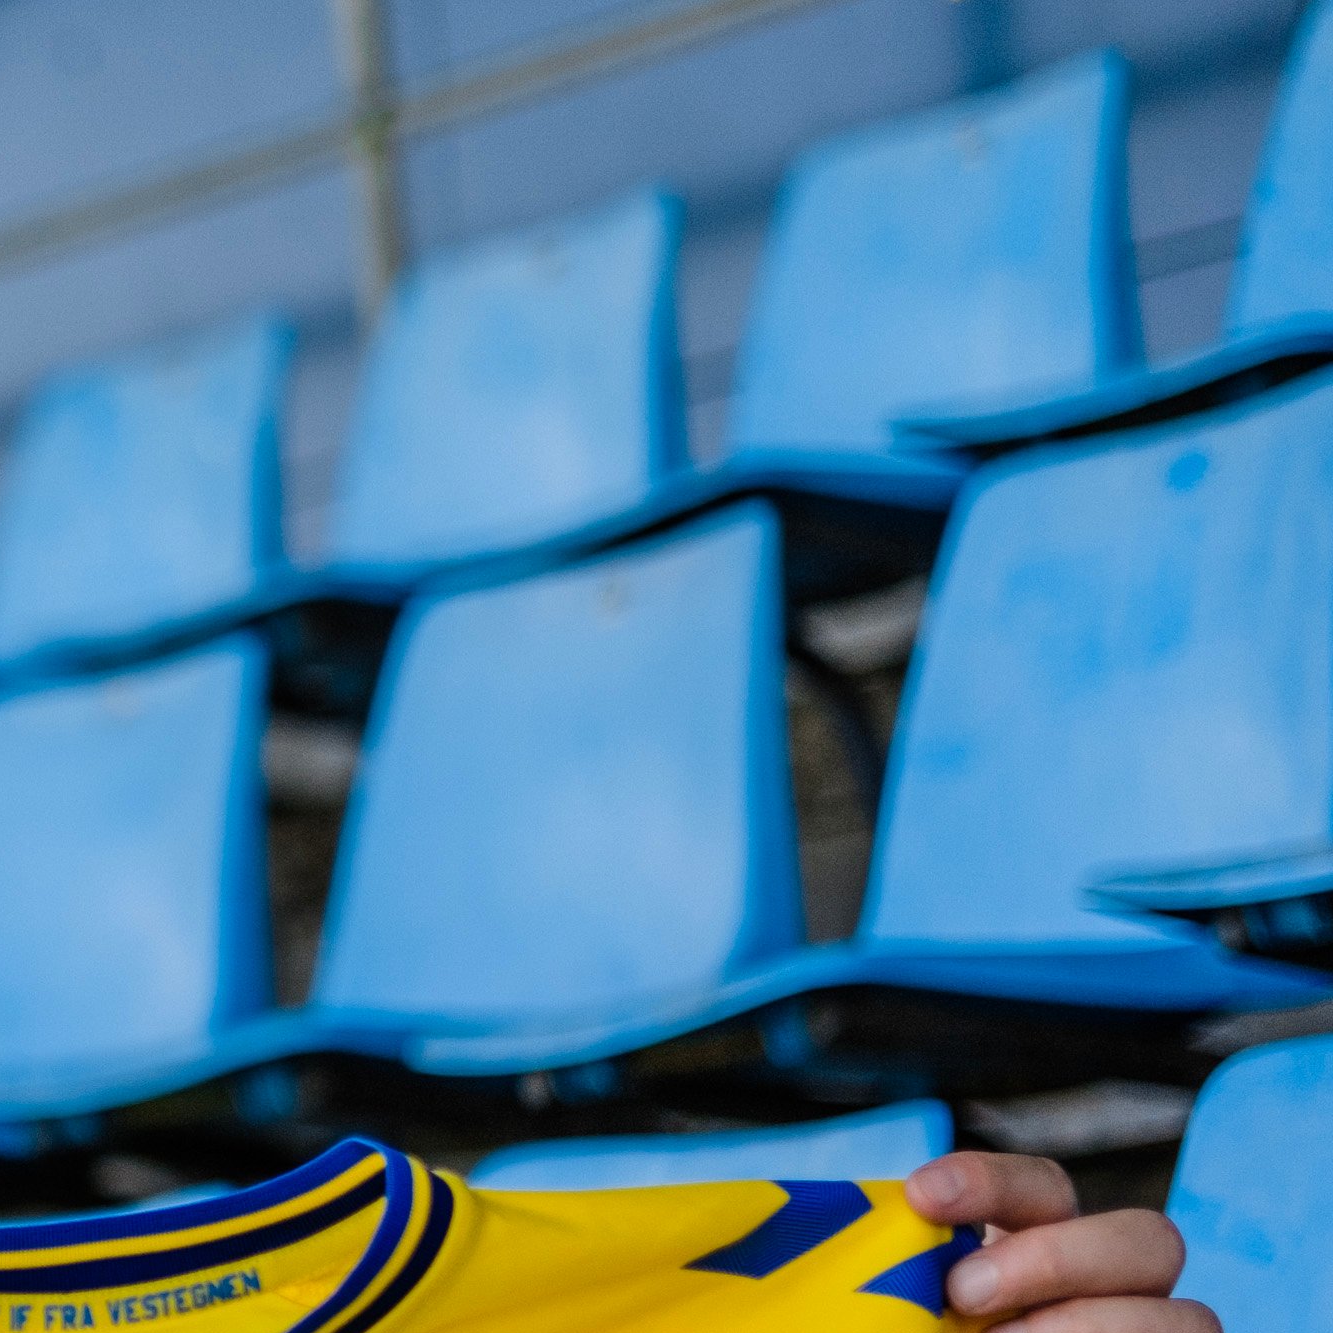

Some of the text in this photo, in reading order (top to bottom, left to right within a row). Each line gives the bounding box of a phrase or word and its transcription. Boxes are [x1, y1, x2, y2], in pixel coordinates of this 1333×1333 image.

[10, 1304, 32, 1331] IF
[44, 1304, 95, 1331] FRA
[107, 1268, 261, 1326] VESTEGNEN
